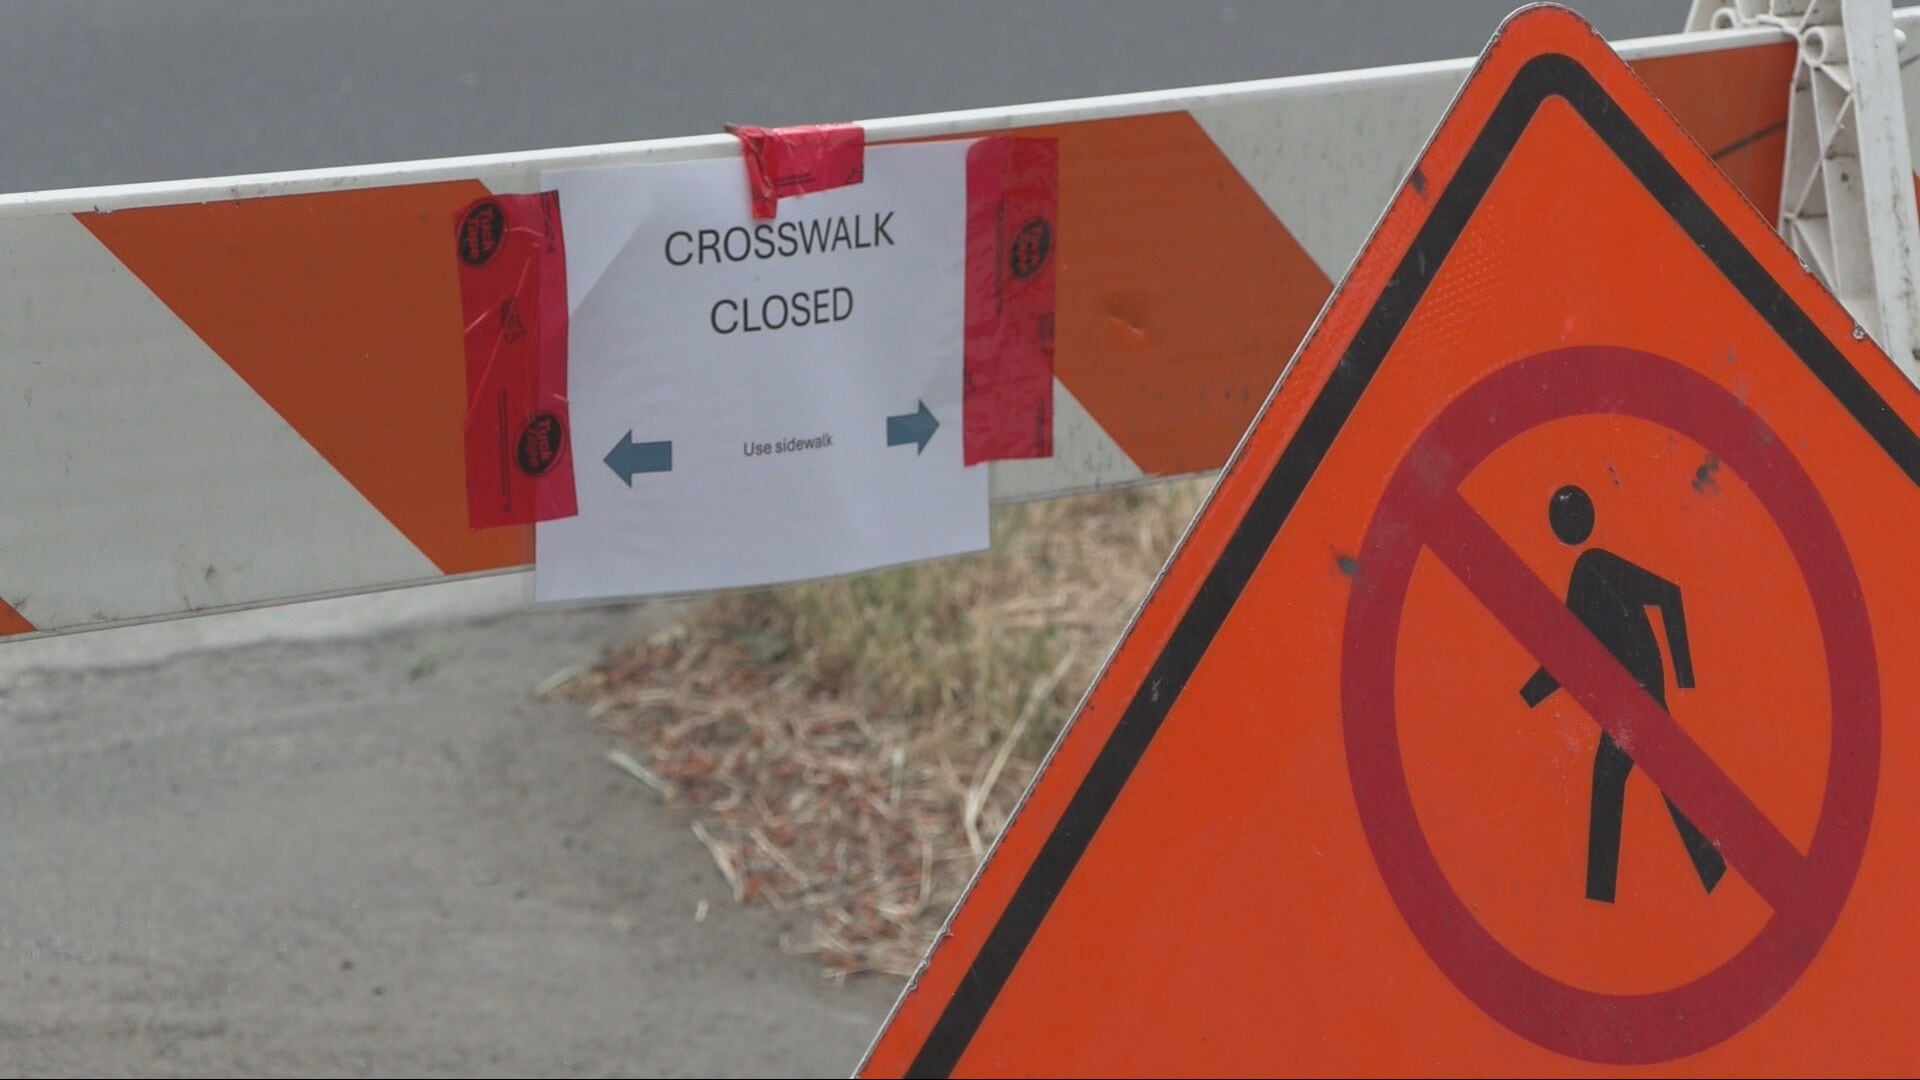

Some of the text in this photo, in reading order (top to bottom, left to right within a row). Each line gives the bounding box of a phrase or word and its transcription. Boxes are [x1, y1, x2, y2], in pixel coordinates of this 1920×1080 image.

[468, 218, 481, 260] Tape
[481, 208, 496, 251] Tuck
[665, 211, 895, 266] CROSSWALK
[710, 286, 854, 335] CLOSED
[538, 418, 553, 461] Tuck
[743, 431, 834, 456] Use sidewalk
